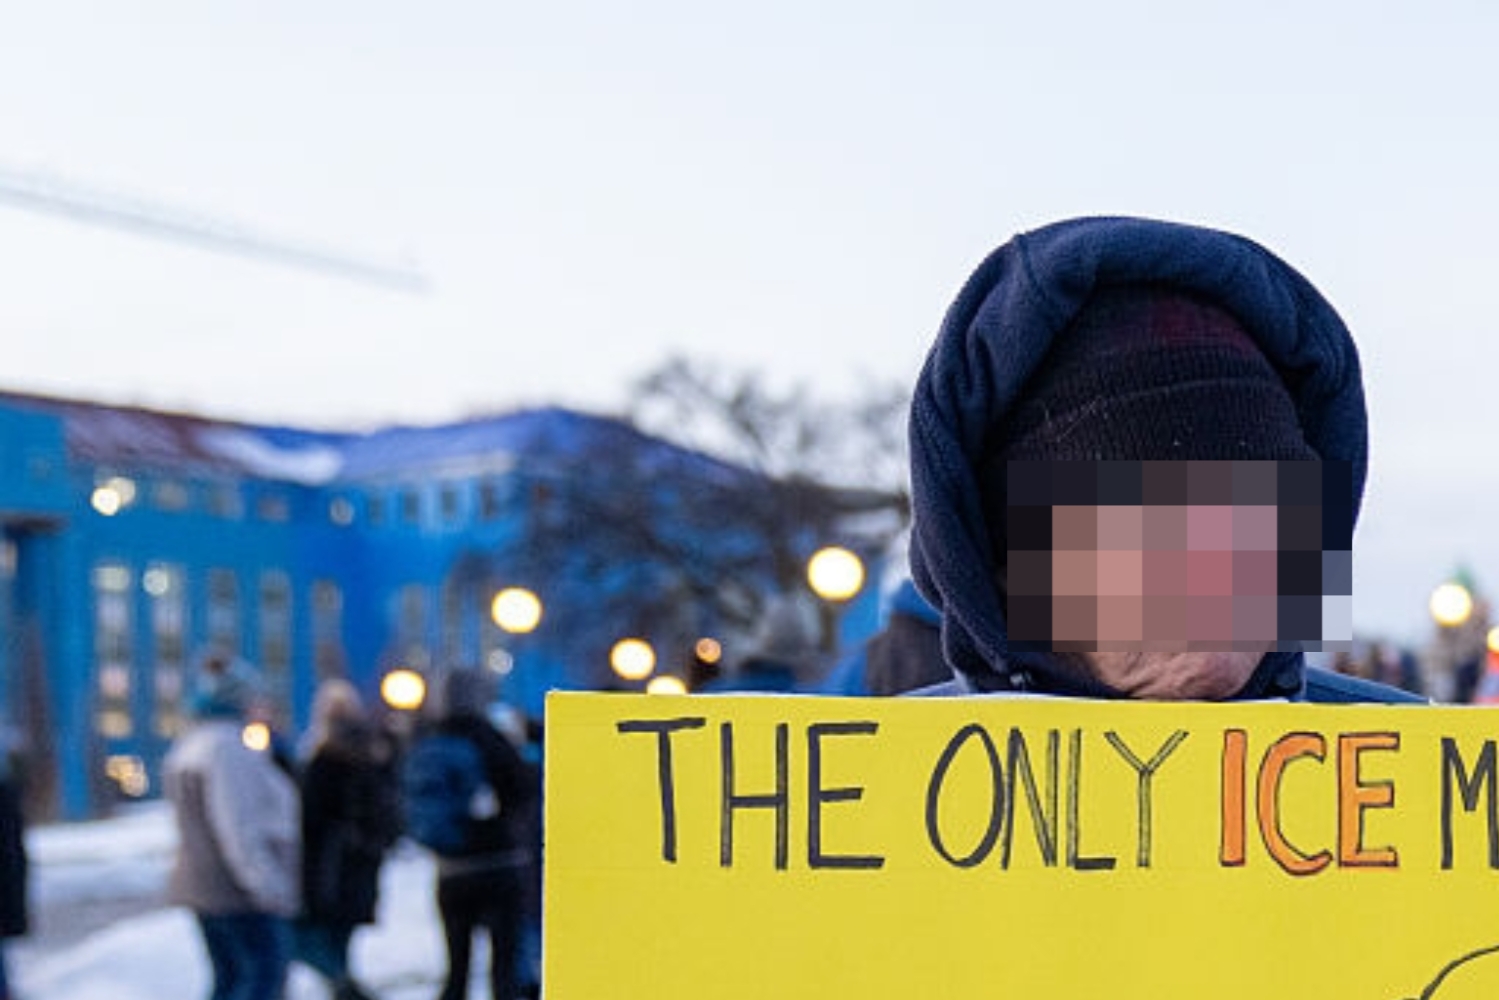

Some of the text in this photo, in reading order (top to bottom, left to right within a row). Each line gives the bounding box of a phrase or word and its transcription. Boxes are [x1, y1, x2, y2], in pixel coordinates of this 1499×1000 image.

[616, 717, 885, 871] THE
[925, 722, 1190, 871] ONLY
[1219, 728, 1401, 876] ICE
